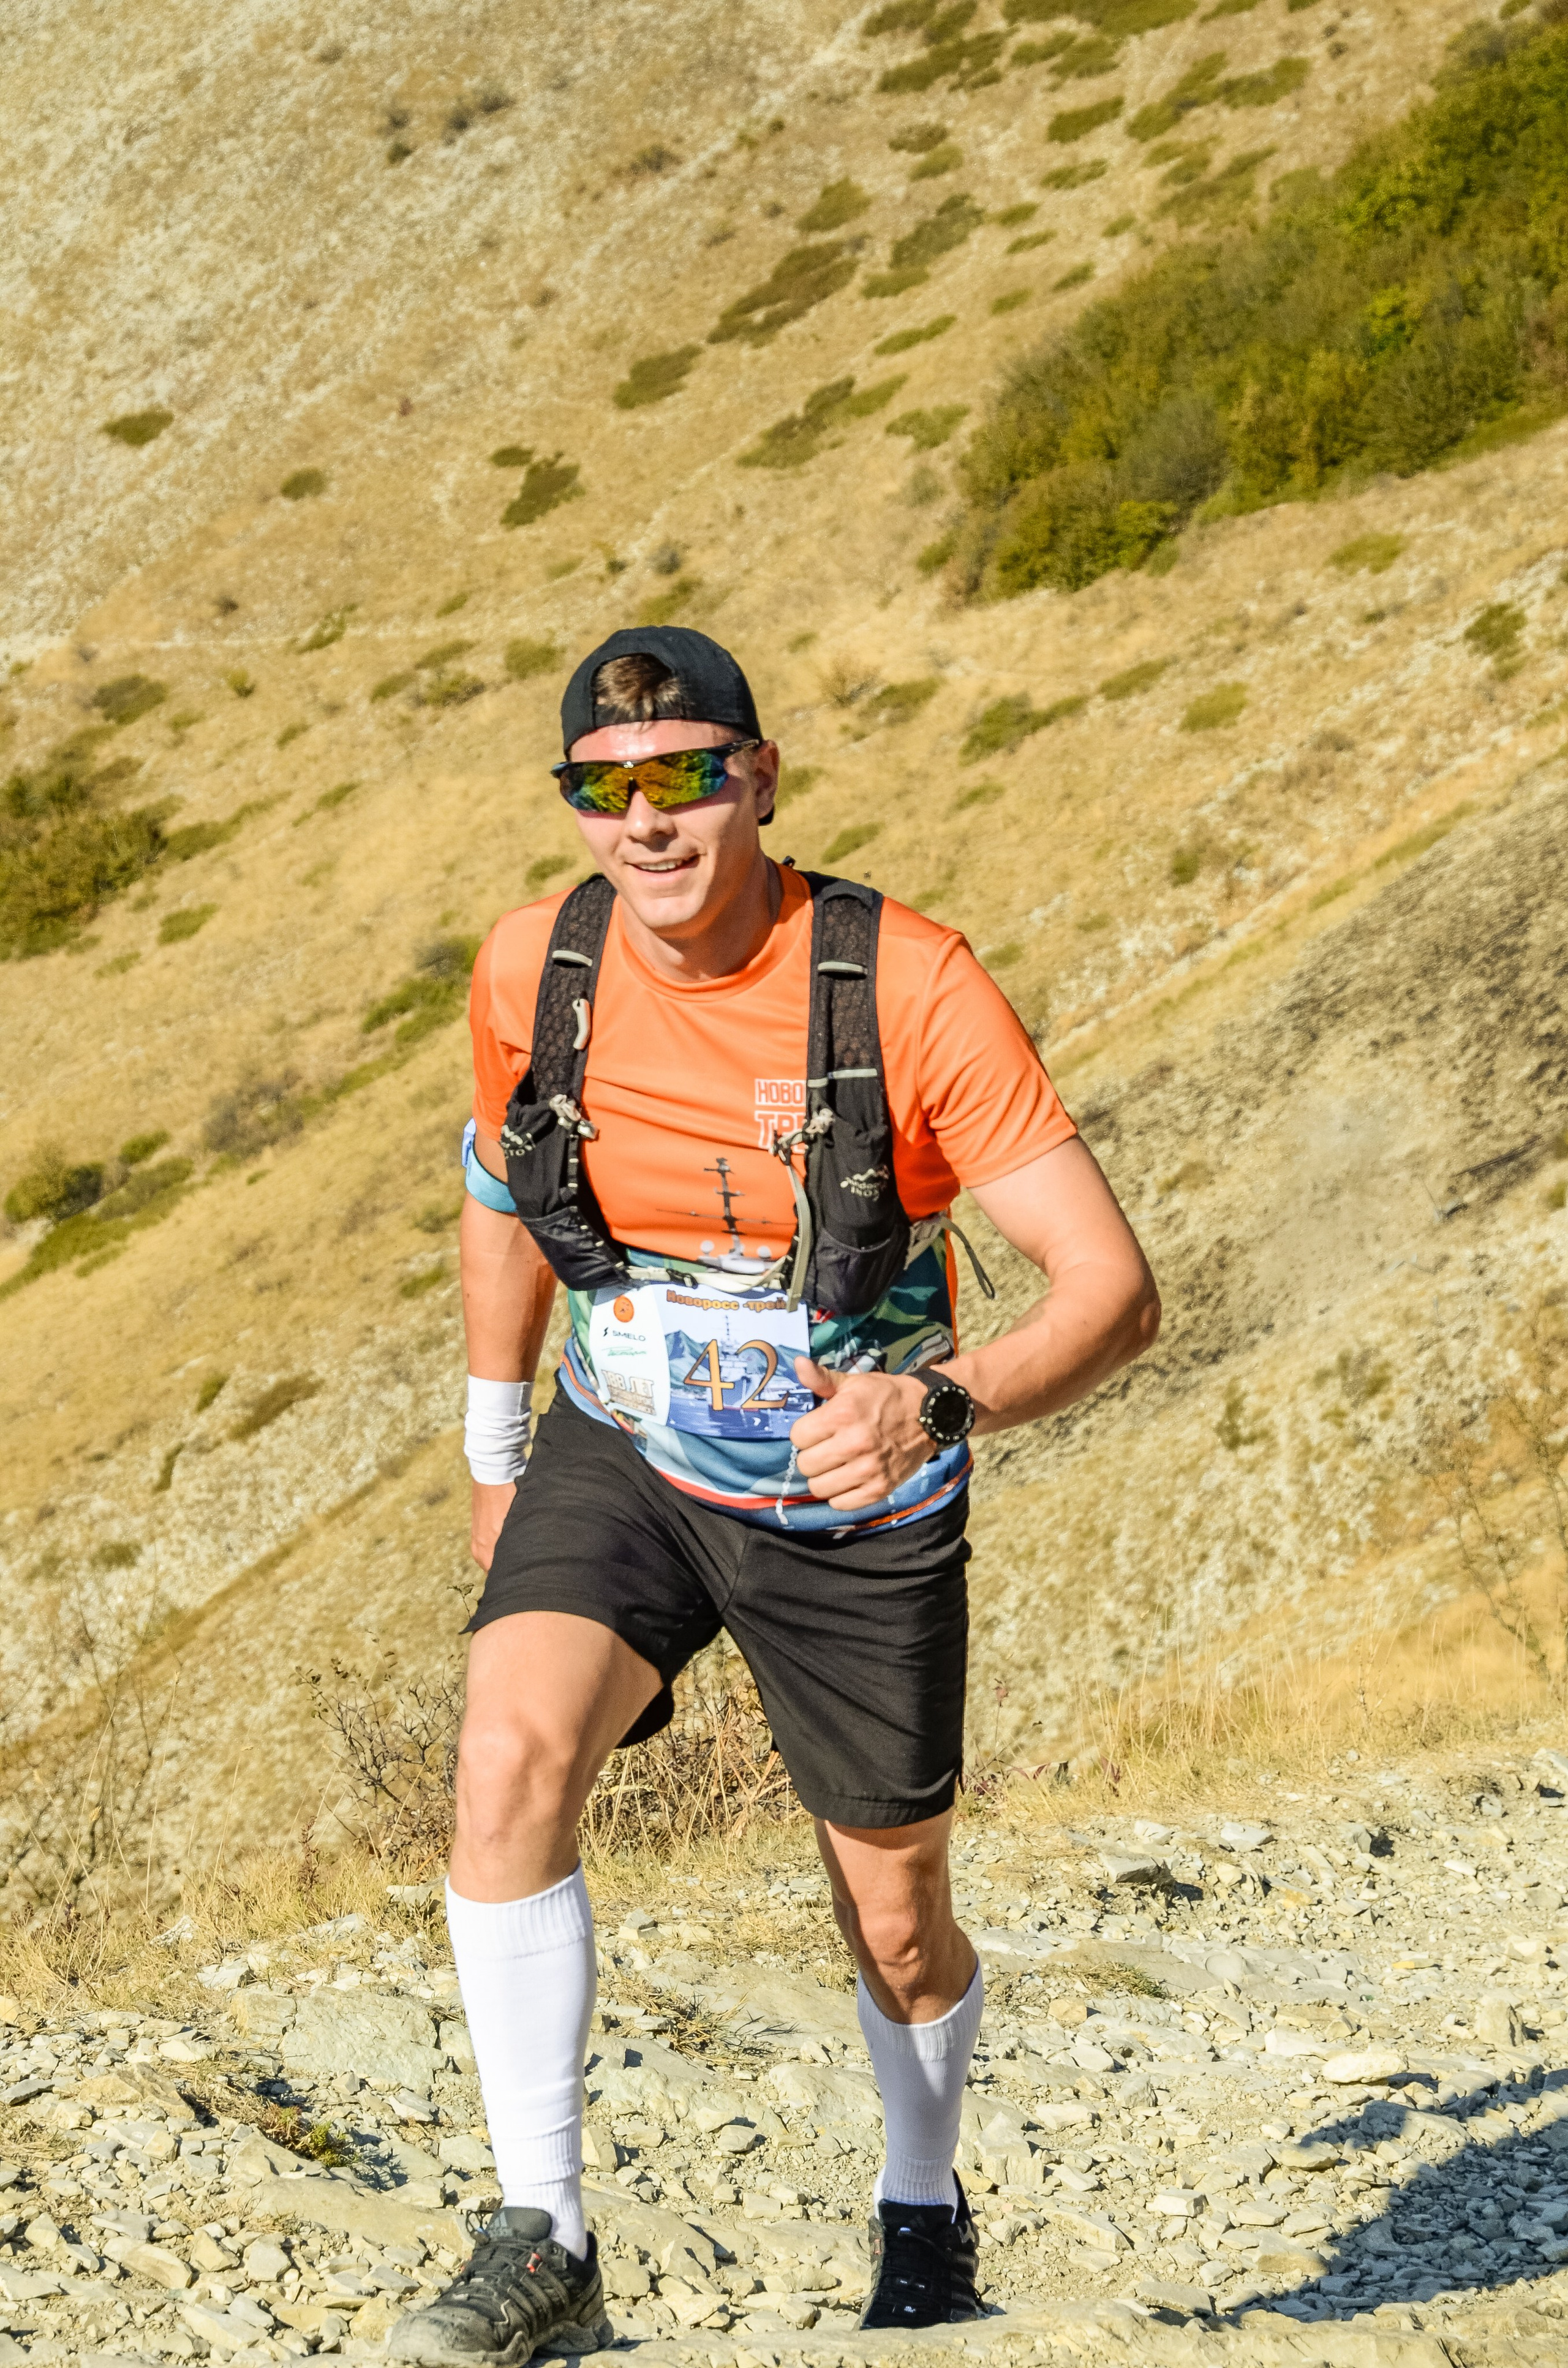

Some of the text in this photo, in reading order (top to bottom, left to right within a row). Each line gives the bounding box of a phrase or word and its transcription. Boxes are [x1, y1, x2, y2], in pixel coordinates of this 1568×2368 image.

[755, 1111, 806, 1152] ТР
[666, 1289, 739, 1311] Новоросс
[684, 1339, 790, 1411] 42
